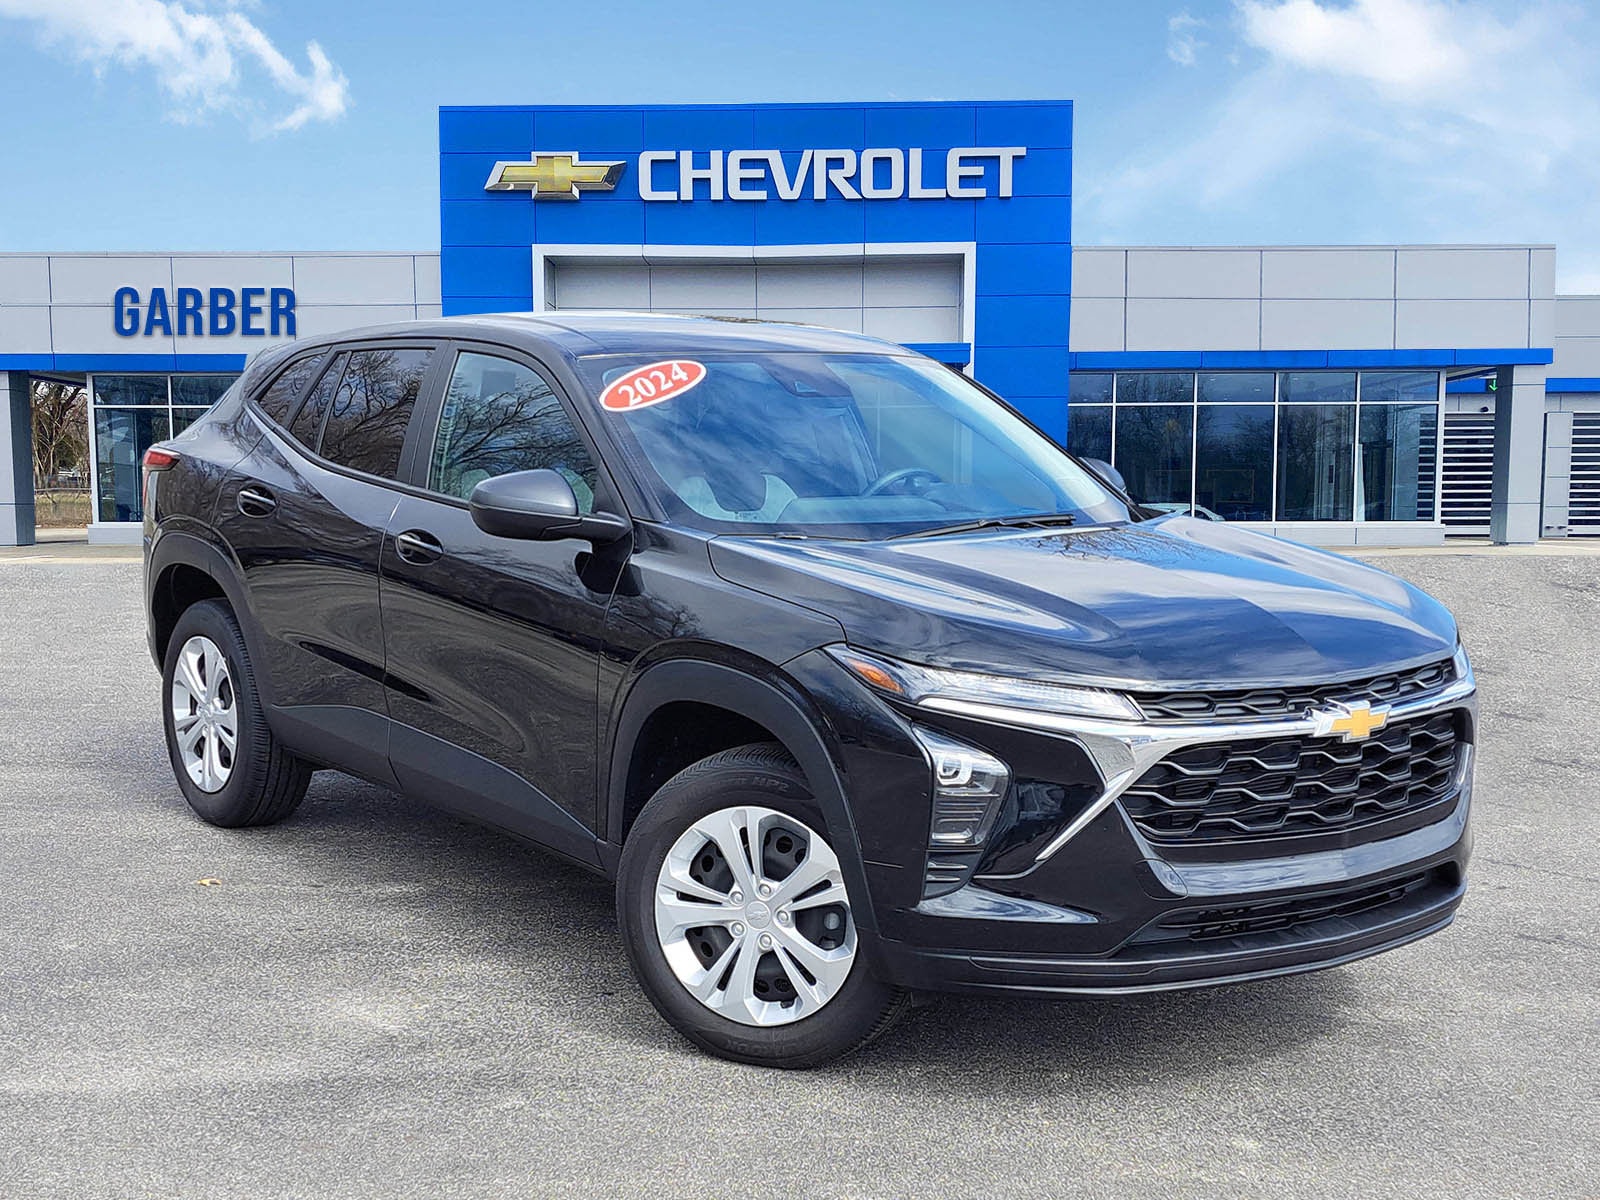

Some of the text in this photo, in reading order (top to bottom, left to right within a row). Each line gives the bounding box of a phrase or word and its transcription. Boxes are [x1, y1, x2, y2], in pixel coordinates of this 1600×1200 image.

[638, 147, 1027, 202] CHEVROLET
[114, 286, 296, 337] GARBER
[618, 362, 689, 406] 2024
